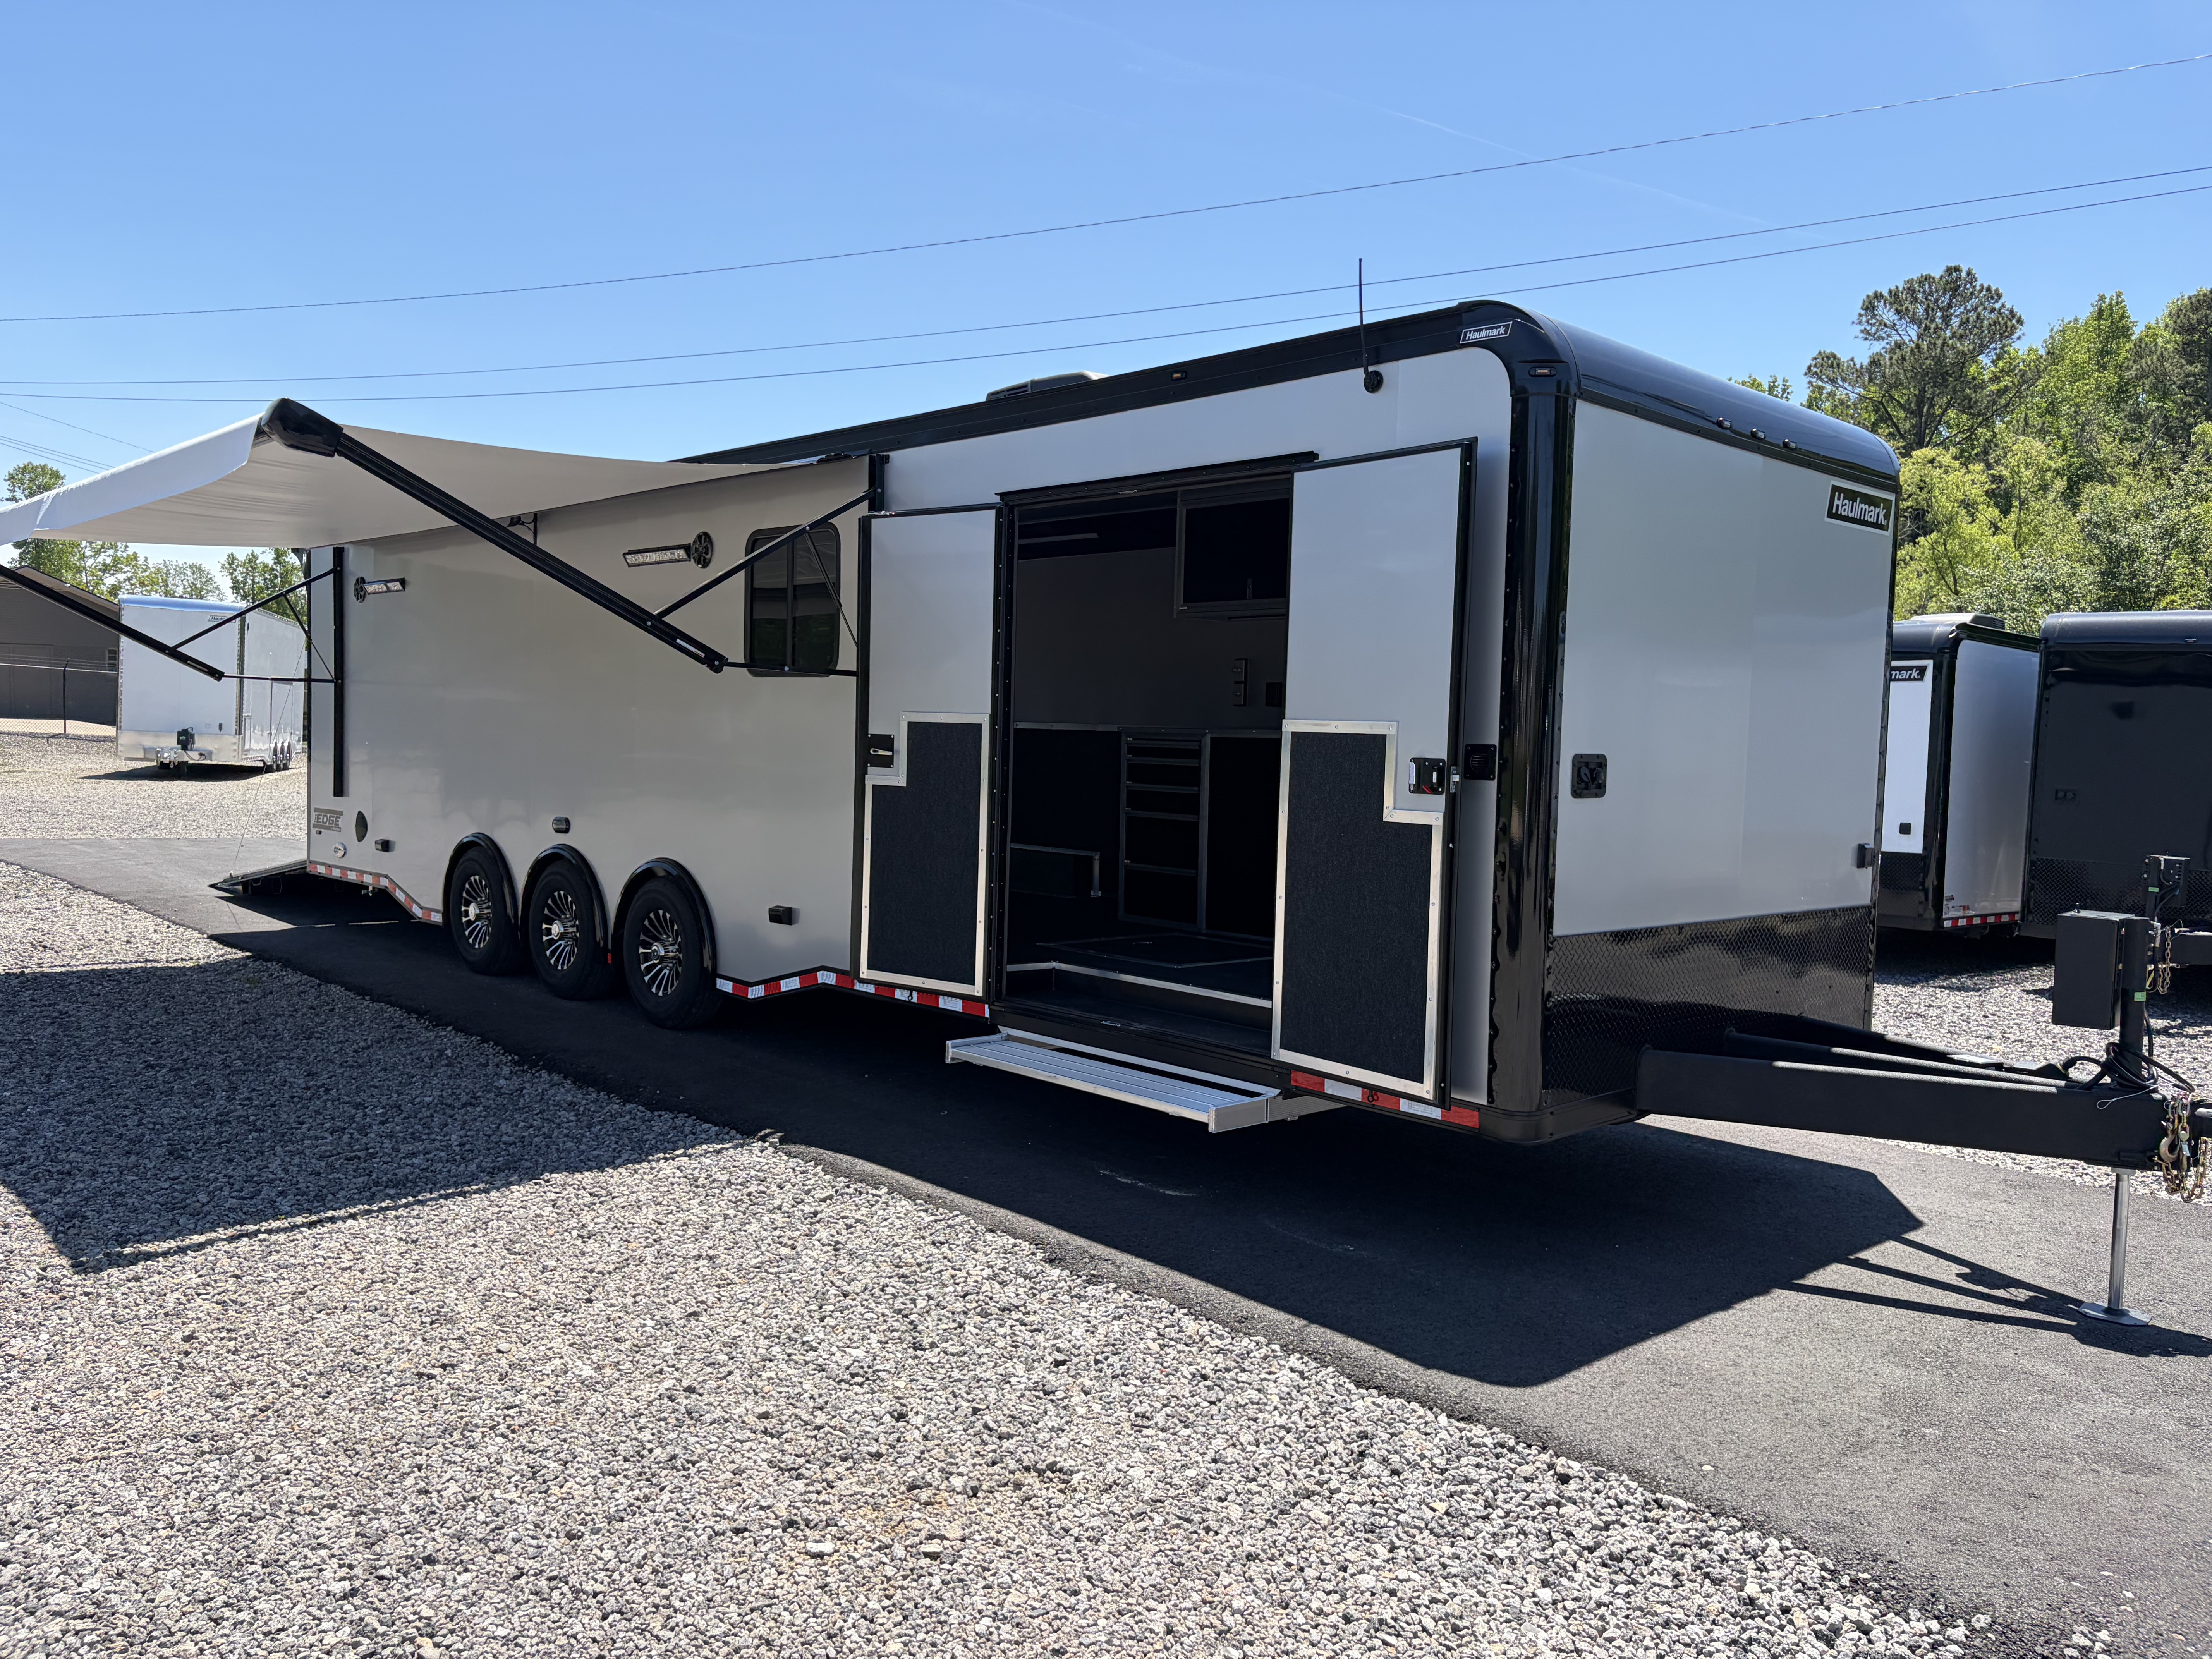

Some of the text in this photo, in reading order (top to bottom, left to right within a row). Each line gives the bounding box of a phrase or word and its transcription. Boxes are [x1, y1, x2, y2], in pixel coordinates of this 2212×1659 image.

[1466, 326, 1506, 340] Haulmark
[1891, 668, 1920, 679] mark
[316, 814, 340, 826] EDGE
